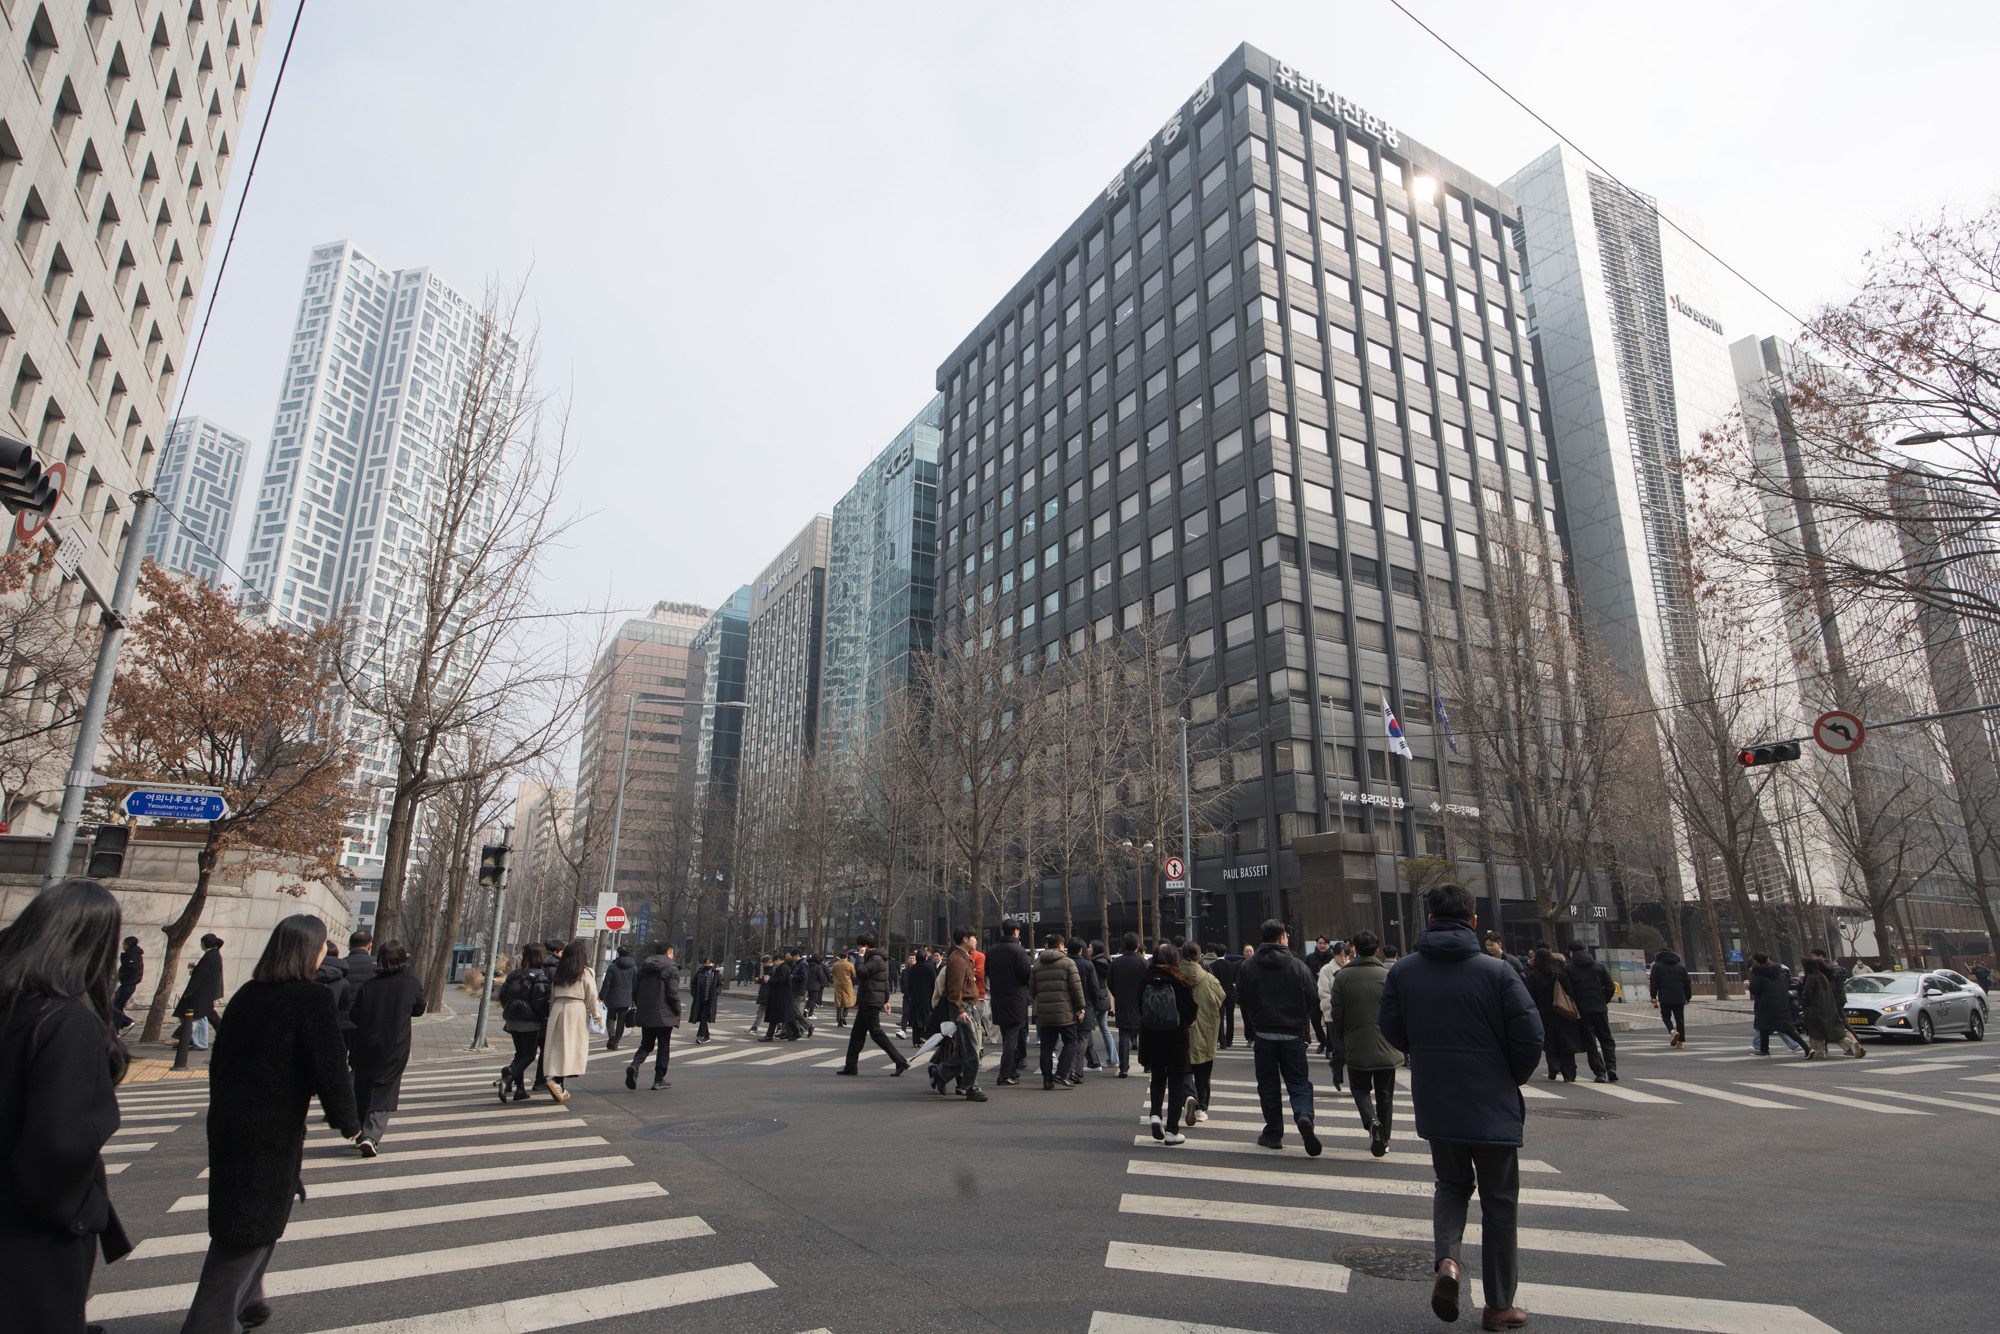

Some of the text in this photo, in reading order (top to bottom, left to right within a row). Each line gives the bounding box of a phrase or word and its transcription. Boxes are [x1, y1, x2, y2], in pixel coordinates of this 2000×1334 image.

[1275, 61, 1400, 149] 유리자산운용
[1106, 73, 1214, 200] 부국증권
[1676, 294, 1723, 335] koscom
[883, 444, 914, 486] KCB
[659, 600, 708, 618] KANTAR
[145, 794, 208, 805] 여의나루로4길
[147, 803, 188, 811] Yeouinaru-ro
[1223, 865, 1268, 880] PAUL BASSETT
